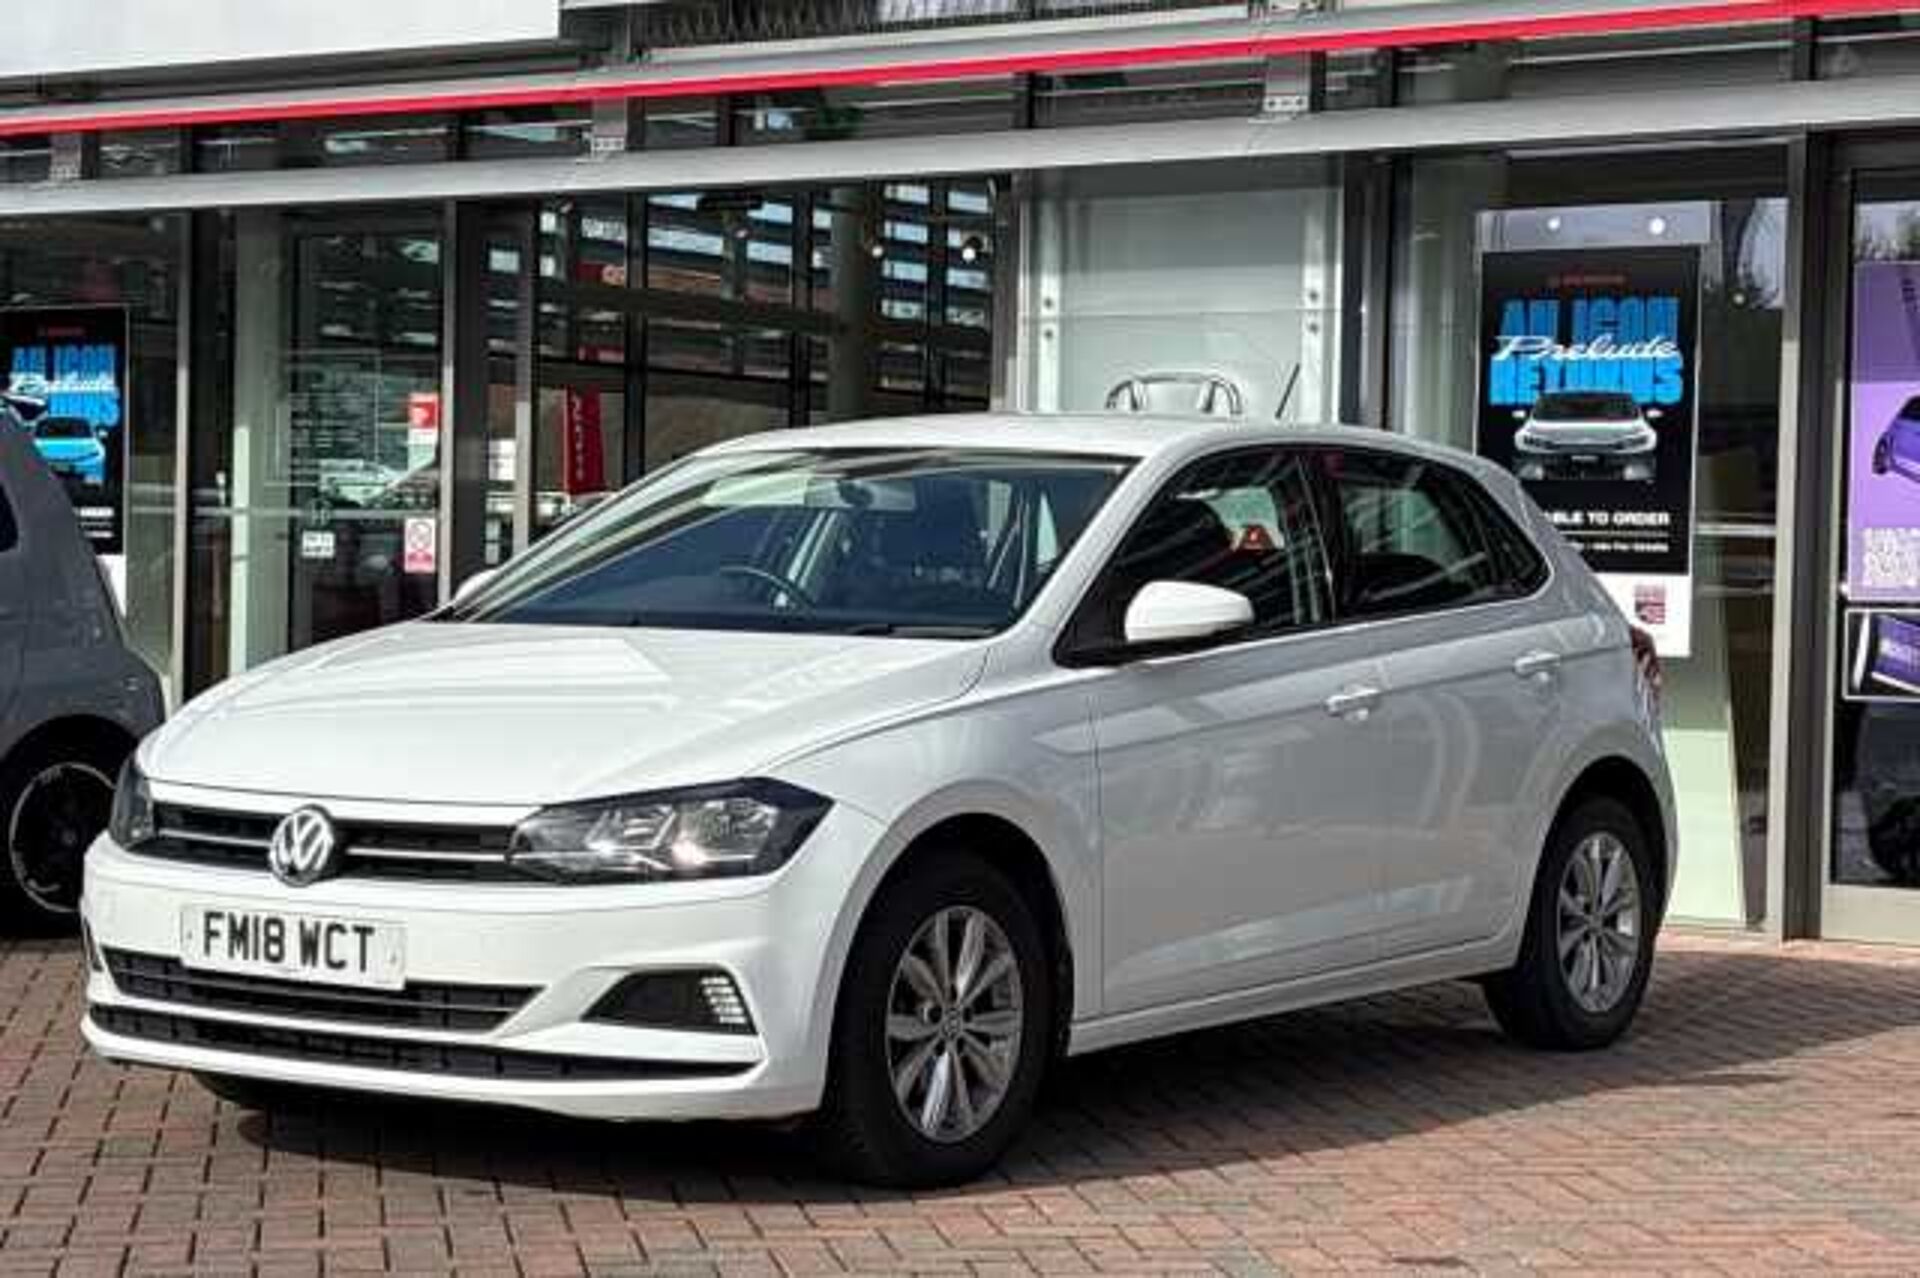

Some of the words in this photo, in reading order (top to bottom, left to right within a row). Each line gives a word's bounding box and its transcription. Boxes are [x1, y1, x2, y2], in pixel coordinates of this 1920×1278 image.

[1494, 333, 1679, 361] Prelude
[203, 911, 285, 964] FM18
[299, 917, 375, 973] WCT
